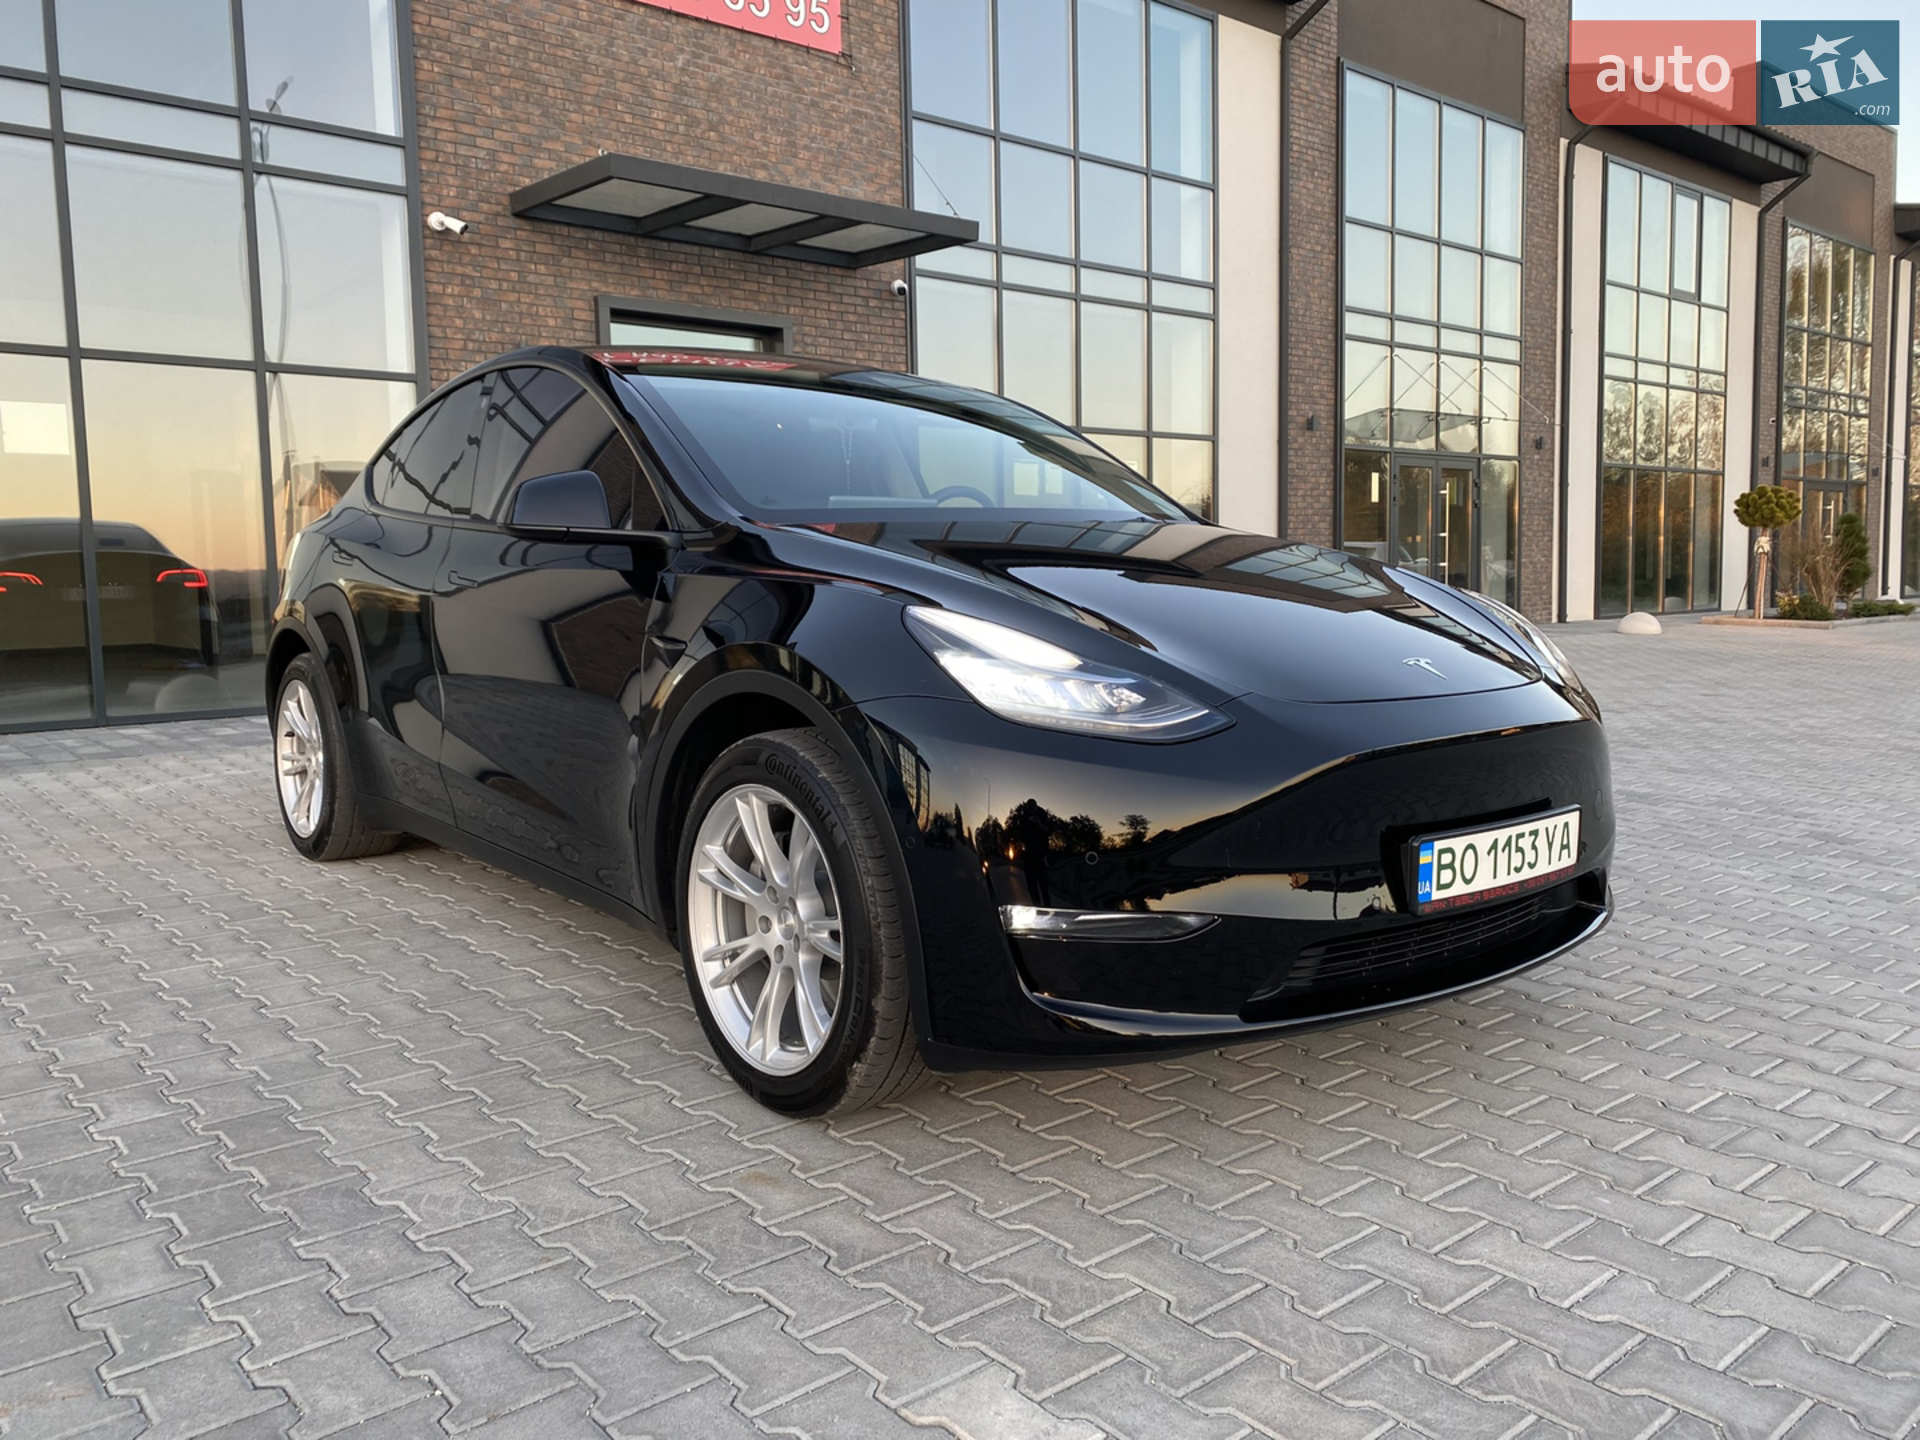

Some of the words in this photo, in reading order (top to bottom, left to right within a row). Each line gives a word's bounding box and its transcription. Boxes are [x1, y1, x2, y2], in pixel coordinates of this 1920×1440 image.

[784, 0, 830, 34] 95
[764, 753, 831, 823] Continental
[1436, 842, 1479, 892] BO
[1486, 828, 1540, 880] 1153
[1545, 821, 1572, 867] YA
[1418, 880, 1432, 895] UA
[1483, 882, 1520, 901] SERVICE
